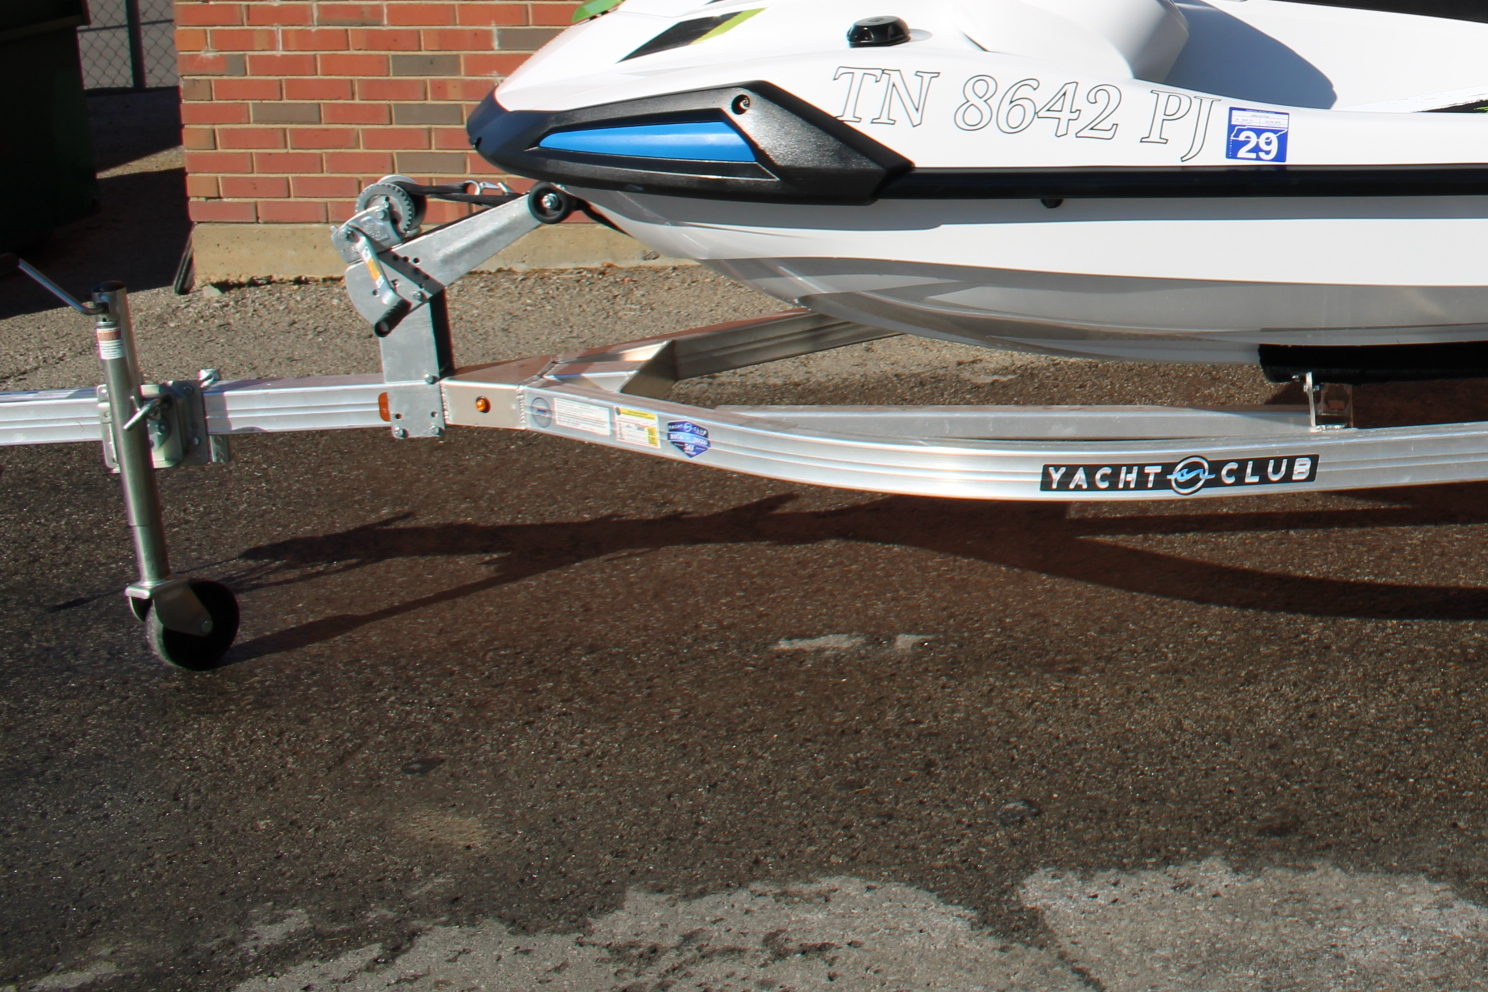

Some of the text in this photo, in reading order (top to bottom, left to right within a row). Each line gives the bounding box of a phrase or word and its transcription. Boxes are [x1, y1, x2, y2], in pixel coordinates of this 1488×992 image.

[833, 66, 1221, 162] TN 8642 PJ
[1236, 130, 1278, 161] 29
[1048, 457, 1312, 489] YACHT CLUB
